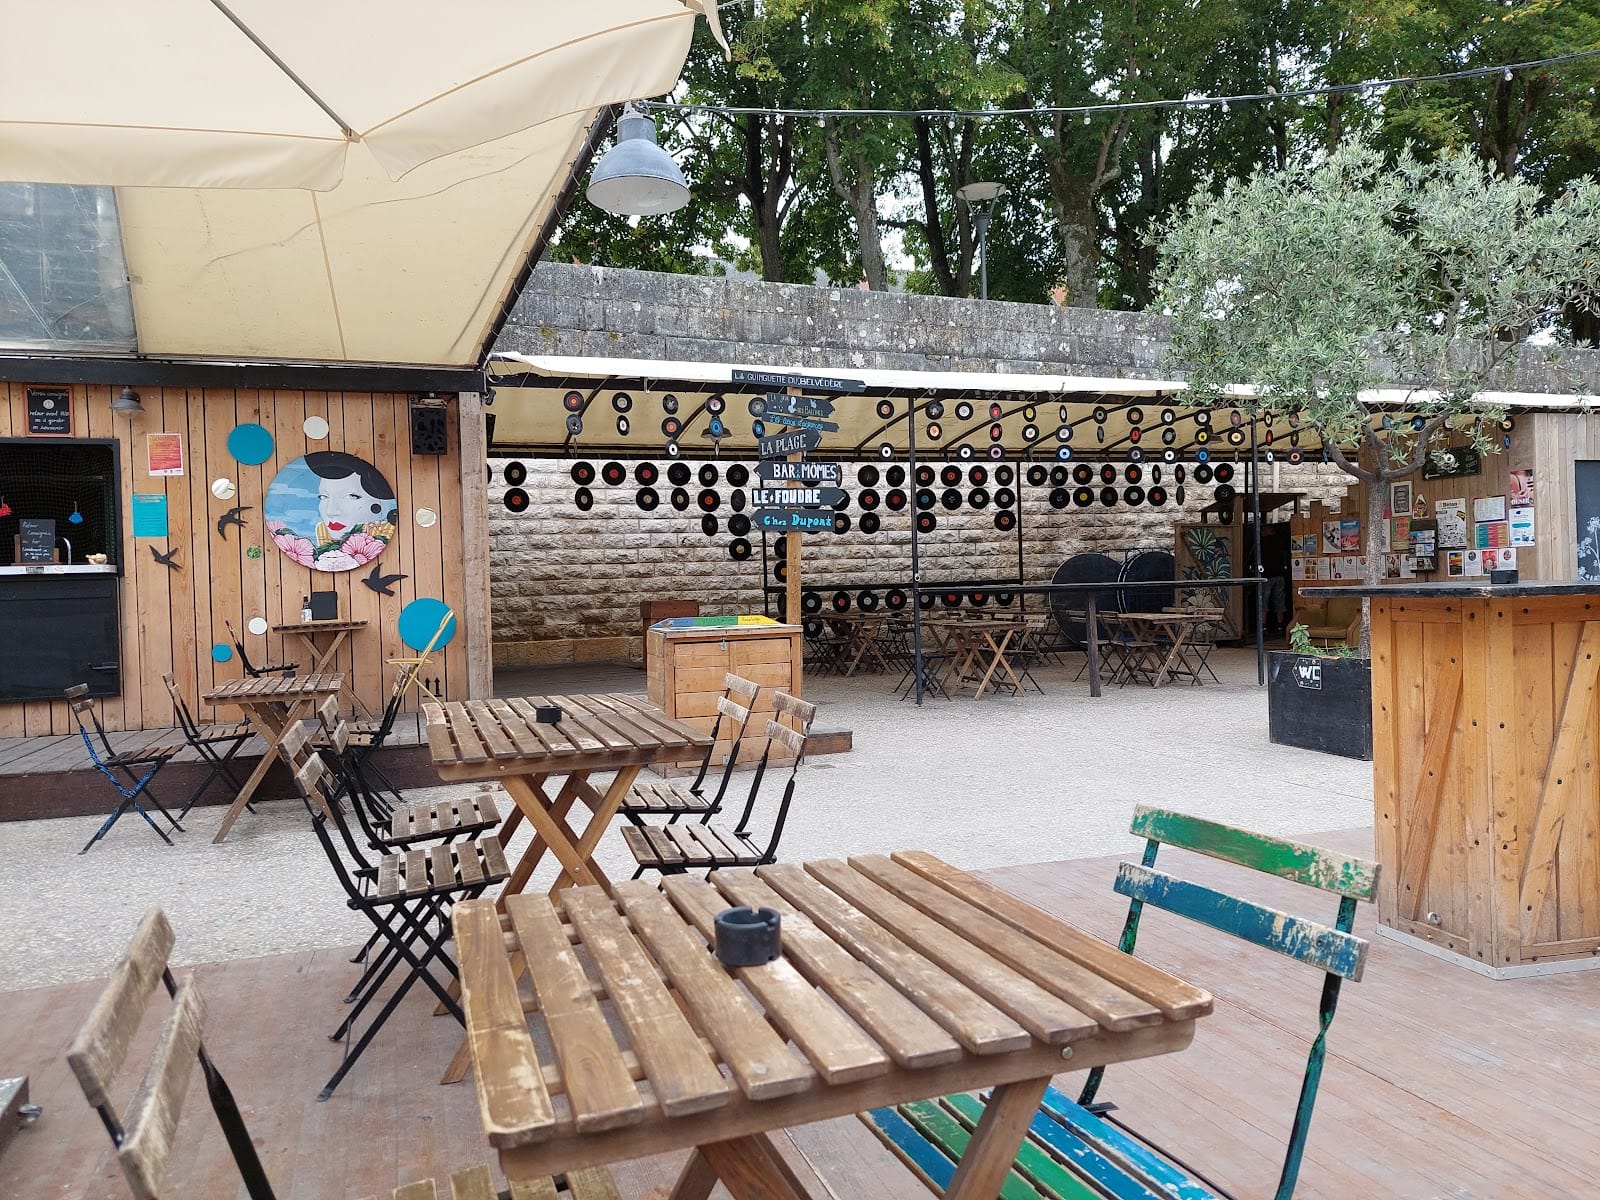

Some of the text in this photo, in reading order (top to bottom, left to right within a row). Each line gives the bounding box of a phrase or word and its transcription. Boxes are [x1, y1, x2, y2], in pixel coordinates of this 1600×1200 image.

[734, 372, 745, 380] LA
[760, 433, 807, 456] LA PLAGE
[773, 463, 795, 478] BAR
[753, 489, 821, 504] LE FOUDRE
[791, 513, 832, 528] Dupont
[1298, 665, 1321, 680] WC
